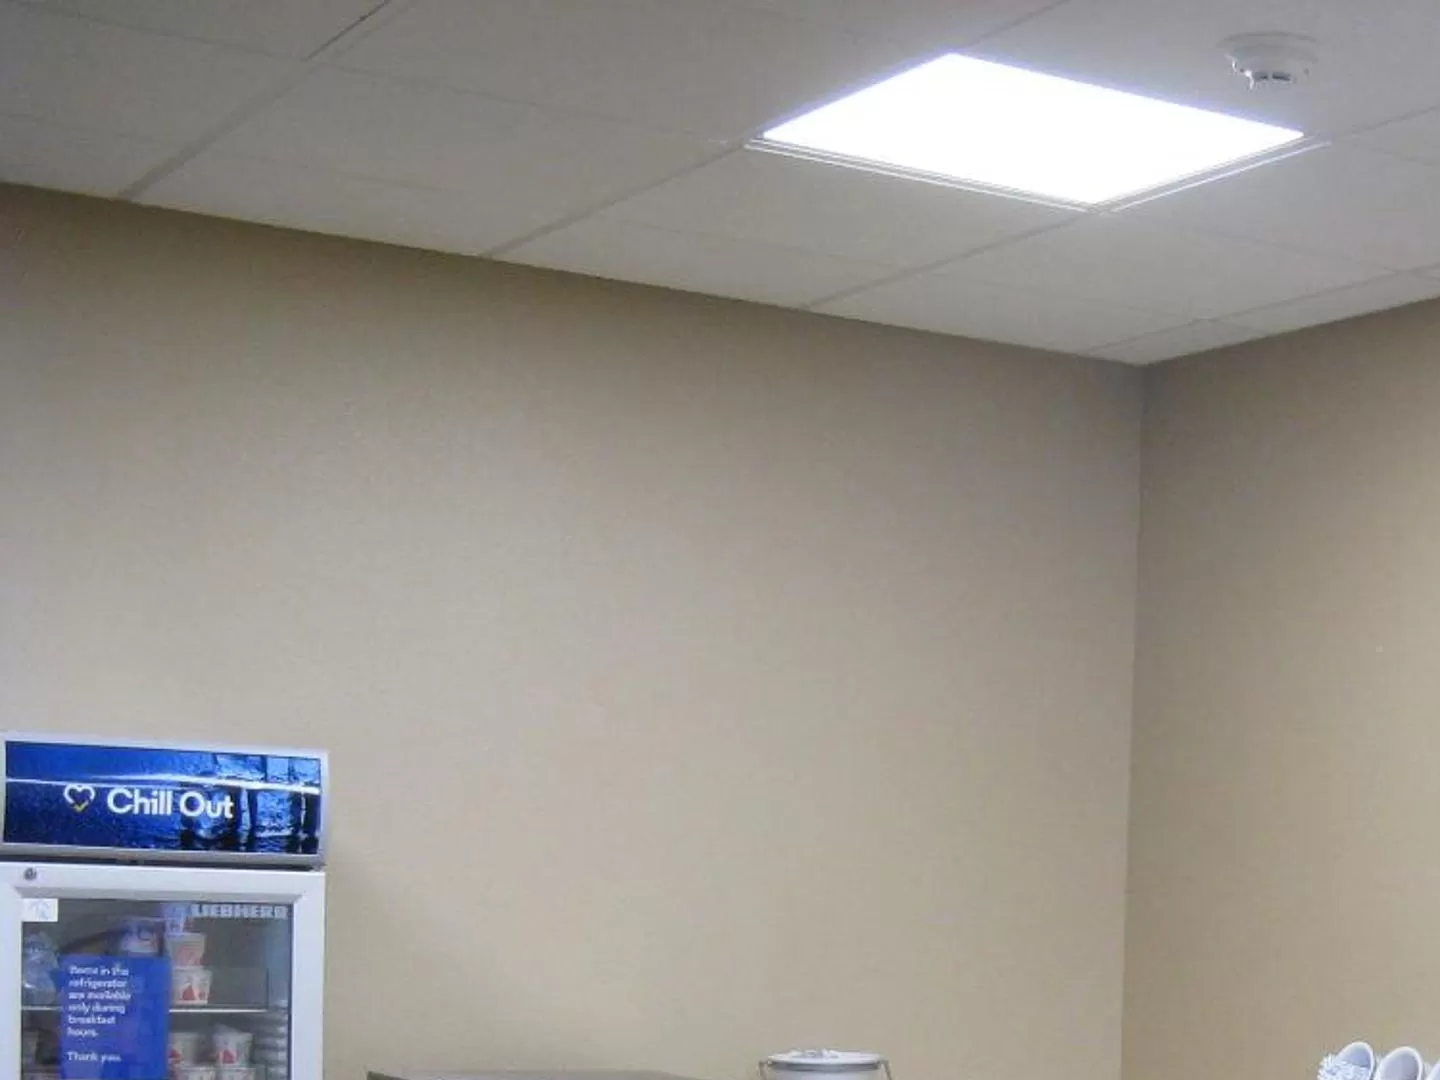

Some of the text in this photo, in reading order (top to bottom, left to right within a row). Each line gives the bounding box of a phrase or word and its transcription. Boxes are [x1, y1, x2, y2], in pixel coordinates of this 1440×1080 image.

[107, 787, 233, 818] Chill Out
[68, 978, 127, 989] refrigerator
[67, 1015, 116, 1024] breakfast
[66, 1051, 98, 1061] Thank
